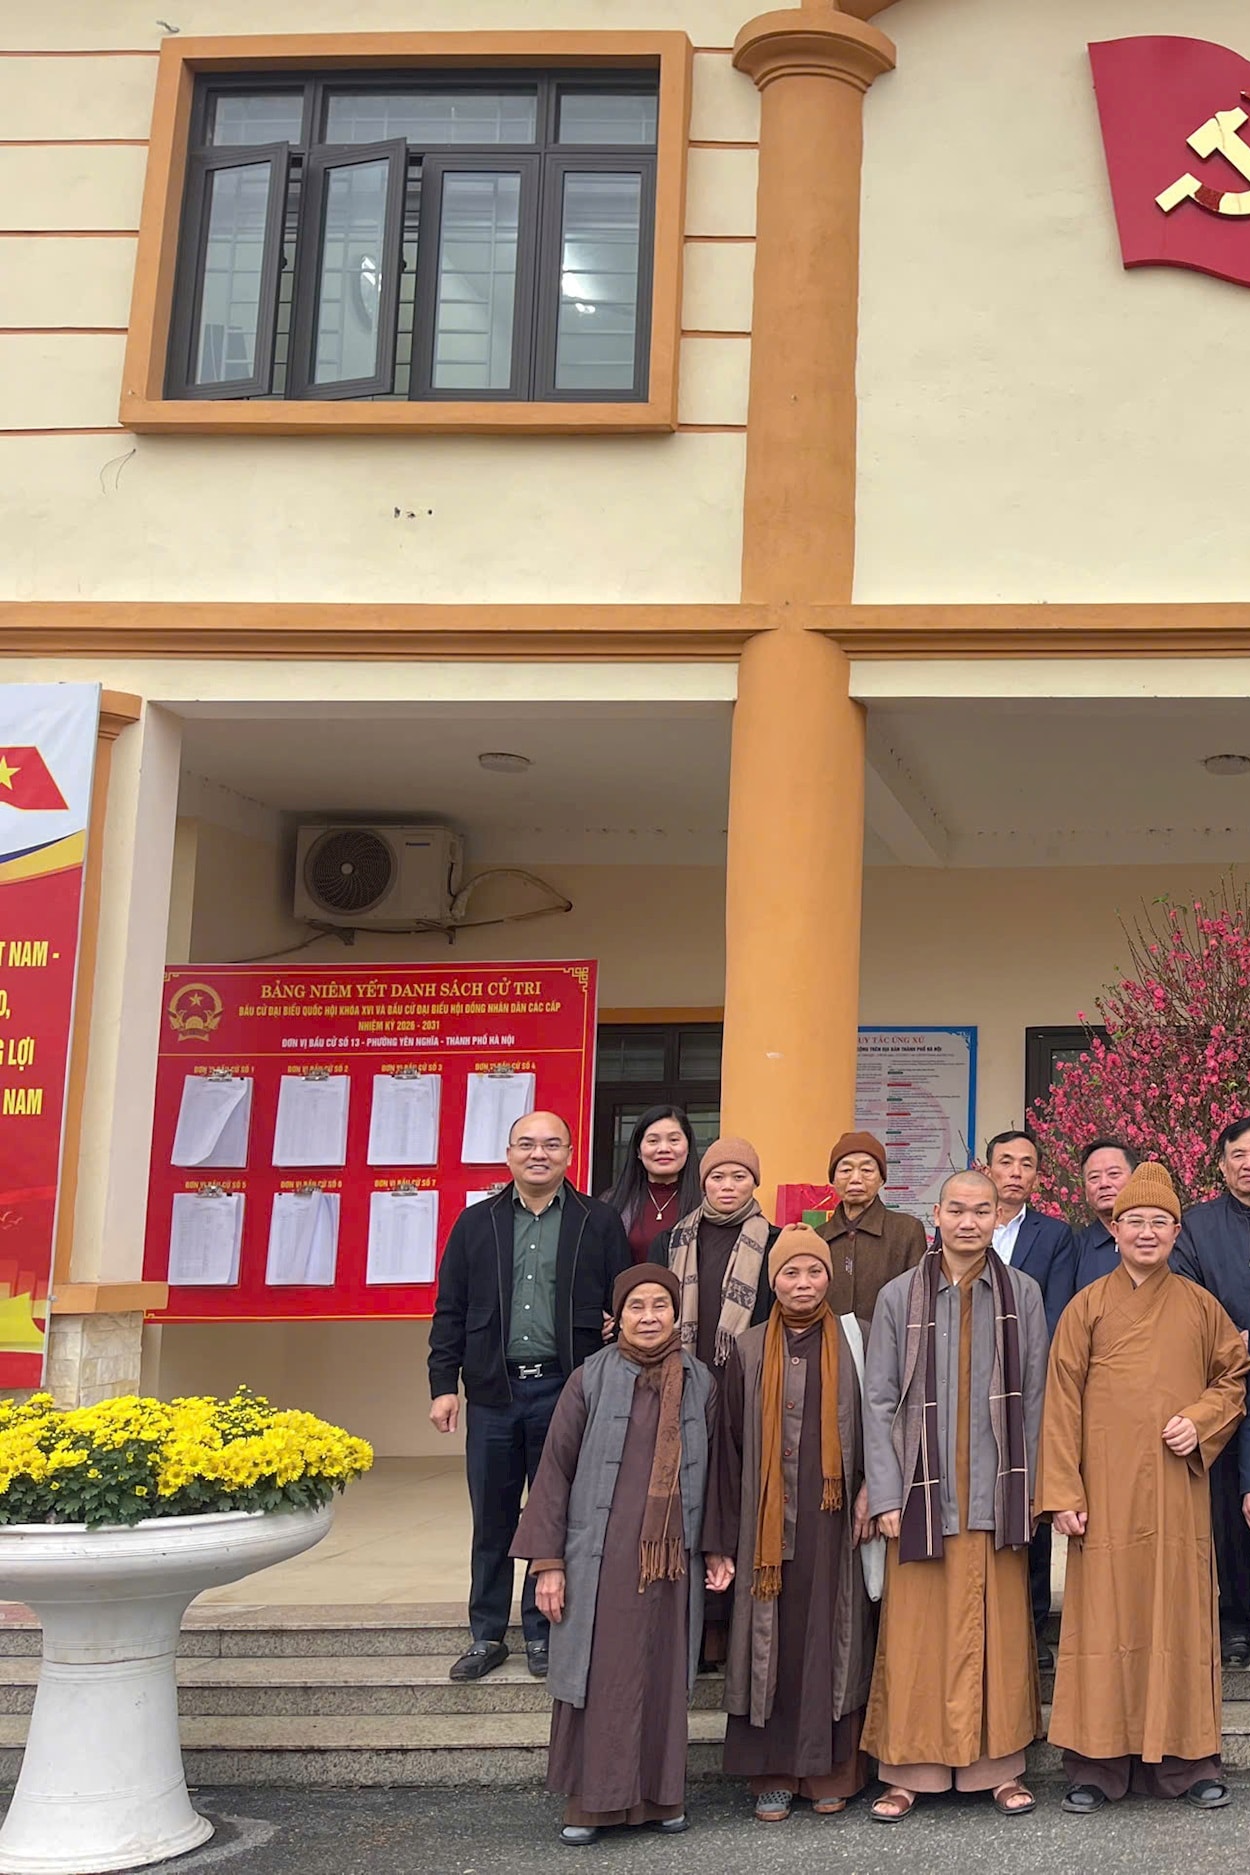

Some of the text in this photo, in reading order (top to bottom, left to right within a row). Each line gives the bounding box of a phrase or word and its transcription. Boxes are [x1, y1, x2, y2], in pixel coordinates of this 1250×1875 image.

[8, 941, 48, 967] NAM
[261, 977, 542, 998] BẢNG NIÊM YẾT DANH SÁCH CỬ TRI
[302, 1003, 322, 1016] QUỐC
[325, 1004, 337, 1018] HỘI
[362, 1005, 374, 1015] XVI
[376, 1003, 386, 1015] VÀ
[450, 1002, 463, 1016] HỘI
[528, 1000, 544, 1012] CÁC
[358, 1020, 384, 1033] NHIỆM
[396, 1020, 416, 1030] 2026
[422, 1020, 440, 1030] 2031
[282, 1038, 298, 1048] ĐƠN
[300, 1038, 308, 1049] VỊ
[338, 1036, 348, 1047] SỐ
[351, 1038, 360, 1047] 13
[366, 1036, 398, 1046] PHƯỜNG
[400, 1036, 414, 1046] YÊN
[416, 1035, 439, 1046] NGHĨA
[446, 1035, 470, 1046] THÀNH
[472, 1034, 488, 1045] PHỐ
[489, 1034, 499, 1045] HÀ
[501, 1034, 515, 1047] NỘI
[857, 1036, 869, 1044] UY
[8, 1036, 36, 1071] LỢI
[2, 1088, 44, 1116] NAM
